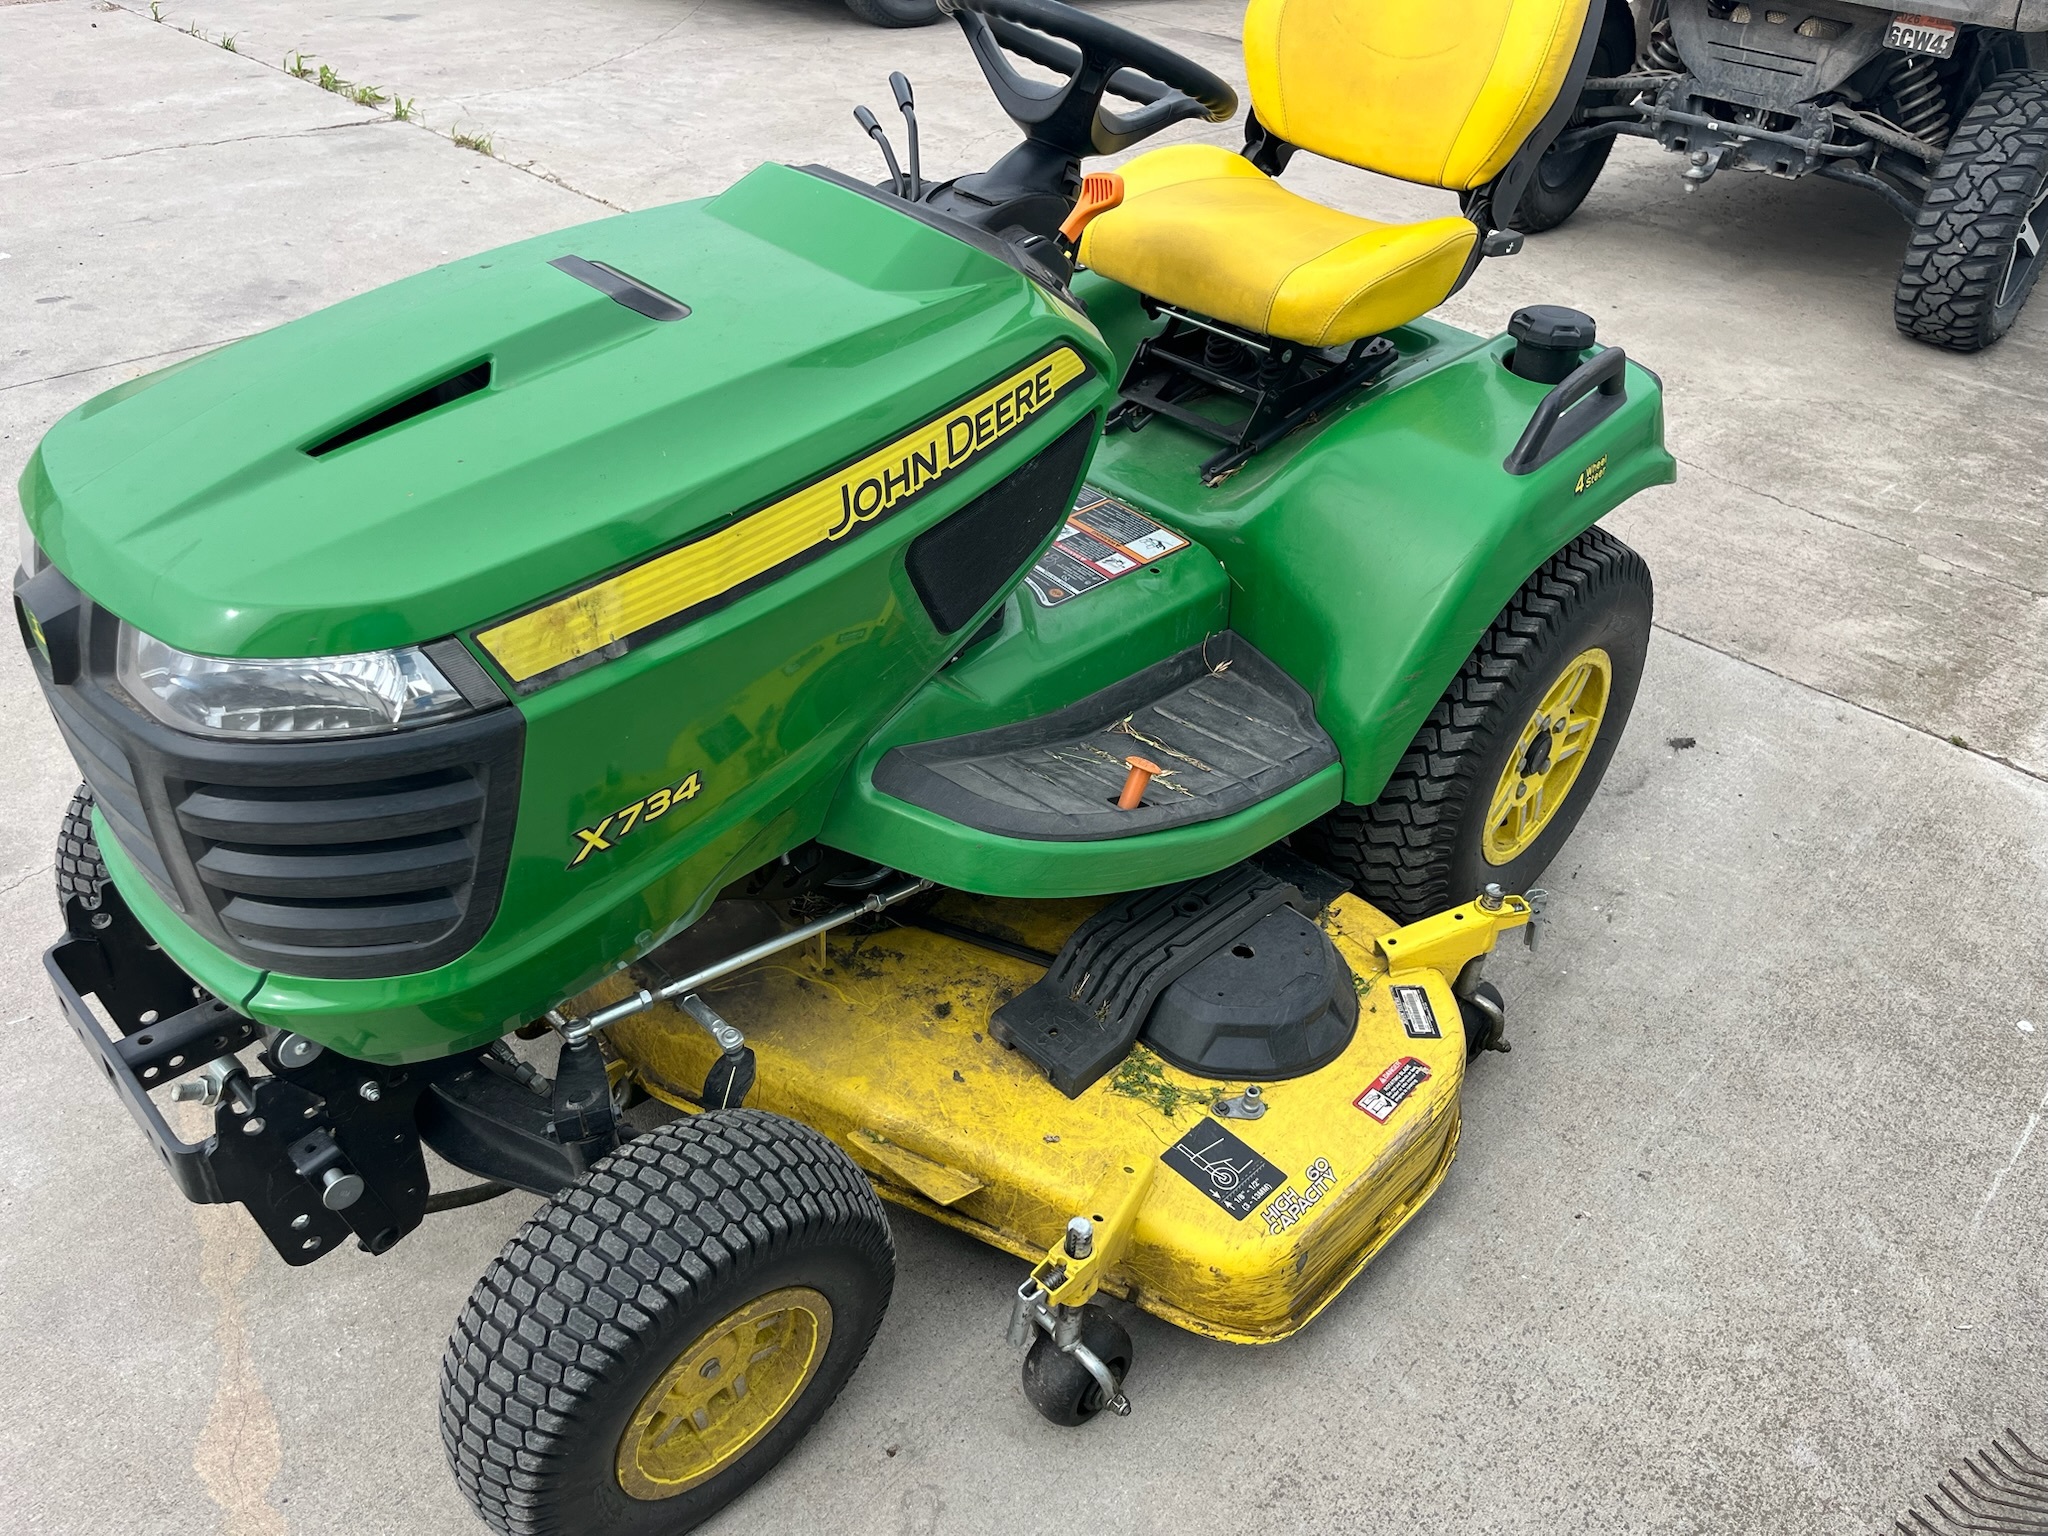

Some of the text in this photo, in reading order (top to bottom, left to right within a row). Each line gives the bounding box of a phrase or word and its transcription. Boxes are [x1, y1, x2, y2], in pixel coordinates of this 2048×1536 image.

[828, 364, 1053, 537] JOHN DEERE
[1586, 453, 1607, 477] Wheel
[1574, 472, 1585, 493] 4
[1586, 466, 1606, 488] Steer
[570, 771, 702, 867] X734
[1382, 1060, 1402, 1079] DANGER
[1260, 1157, 1330, 1226] HIGH 60
[1269, 1166, 1338, 1236] CAPACITY
